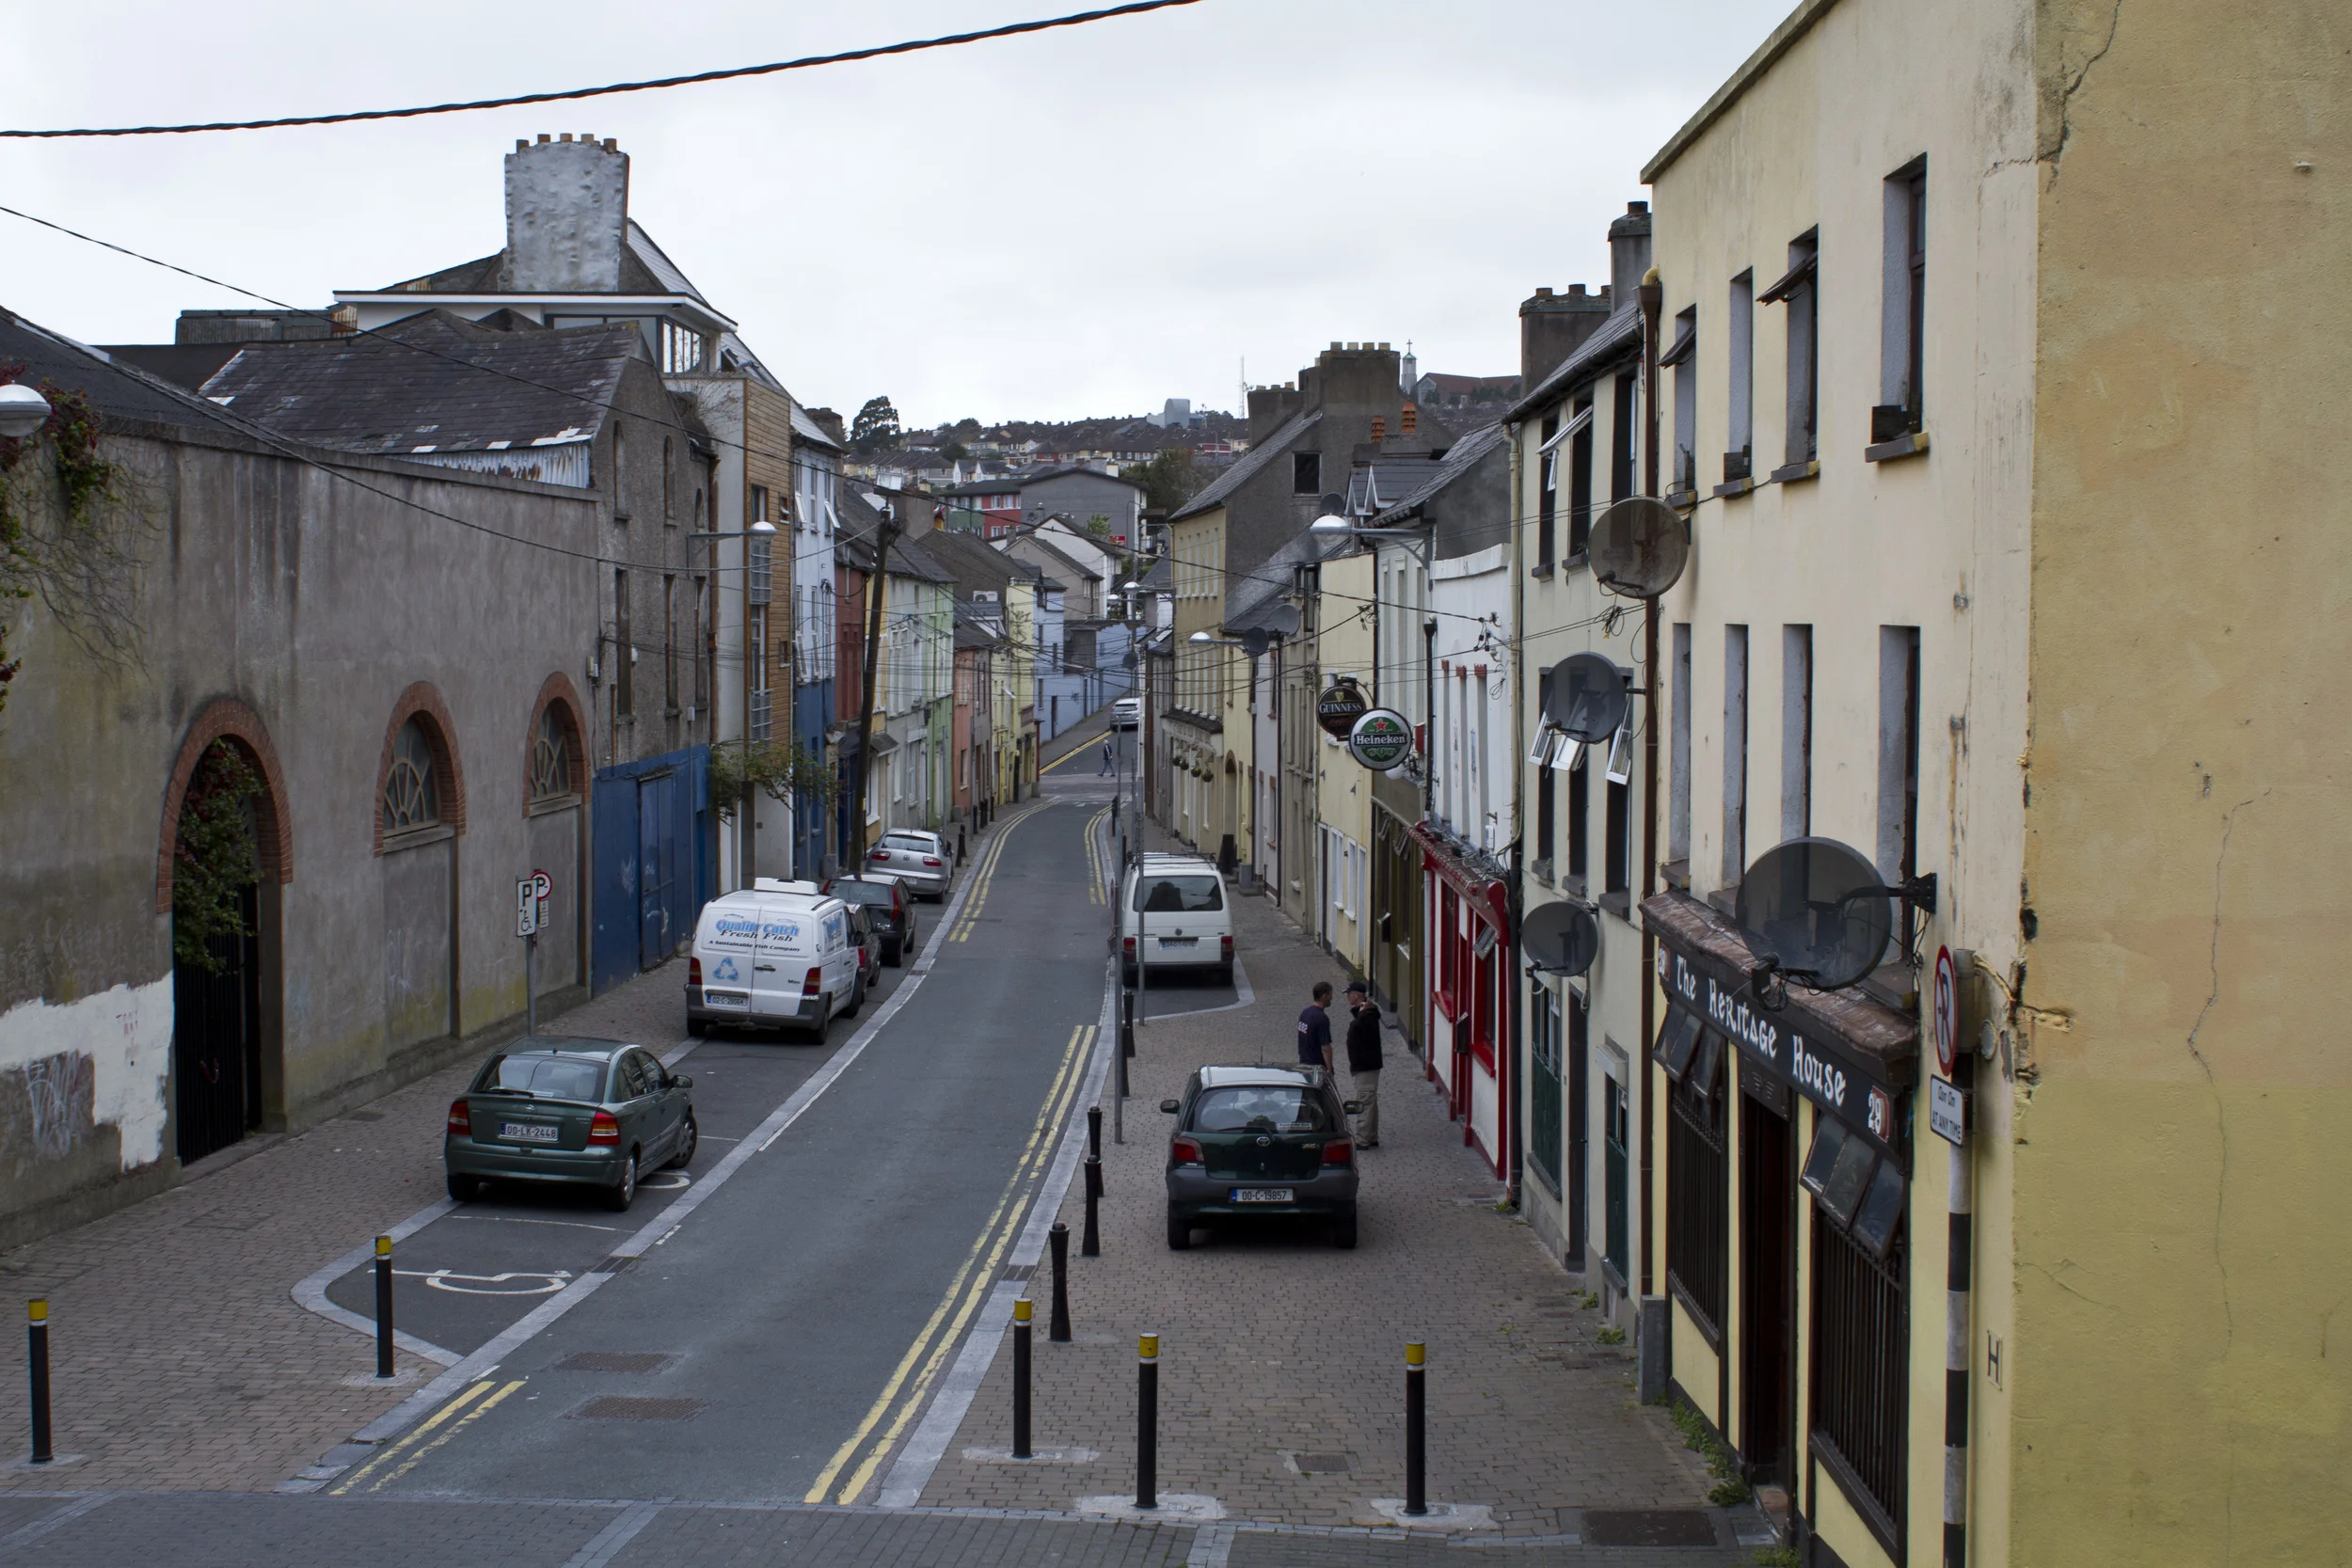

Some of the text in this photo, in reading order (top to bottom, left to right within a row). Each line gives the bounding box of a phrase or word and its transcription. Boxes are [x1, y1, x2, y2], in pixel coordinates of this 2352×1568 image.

[1318, 703, 1362, 714] GUINNESS
[1356, 735, 1406, 744] Heineken
[522, 884, 532, 907] P
[716, 919, 801, 936] Quality Catch
[720, 929, 793, 942] Fresh Fish
[1677, 955, 1696, 1001] The
[1793, 1035, 1847, 1107] House
[507, 1126, 557, 1138] 00-LK-2448
[1939, 1114, 1948, 1132] ANY
[1949, 1119, 1961, 1140] TIME
[1987, 1334, 1999, 1383] H
